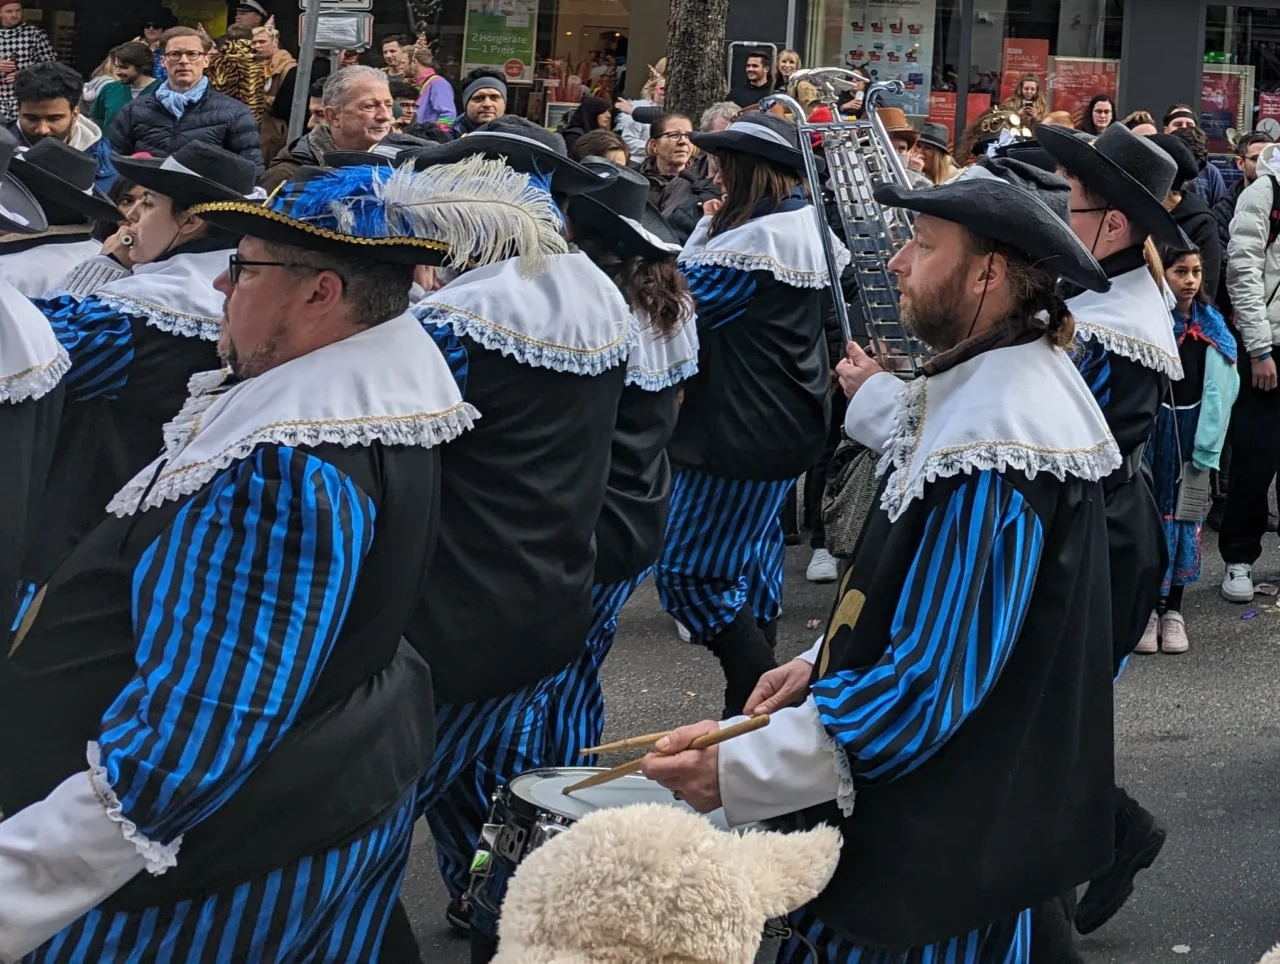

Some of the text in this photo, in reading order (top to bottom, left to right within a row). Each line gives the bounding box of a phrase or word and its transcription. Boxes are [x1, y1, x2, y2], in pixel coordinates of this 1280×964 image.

[471, 32, 478, 42] 2
[482, 44, 515, 54] 1 Preis
